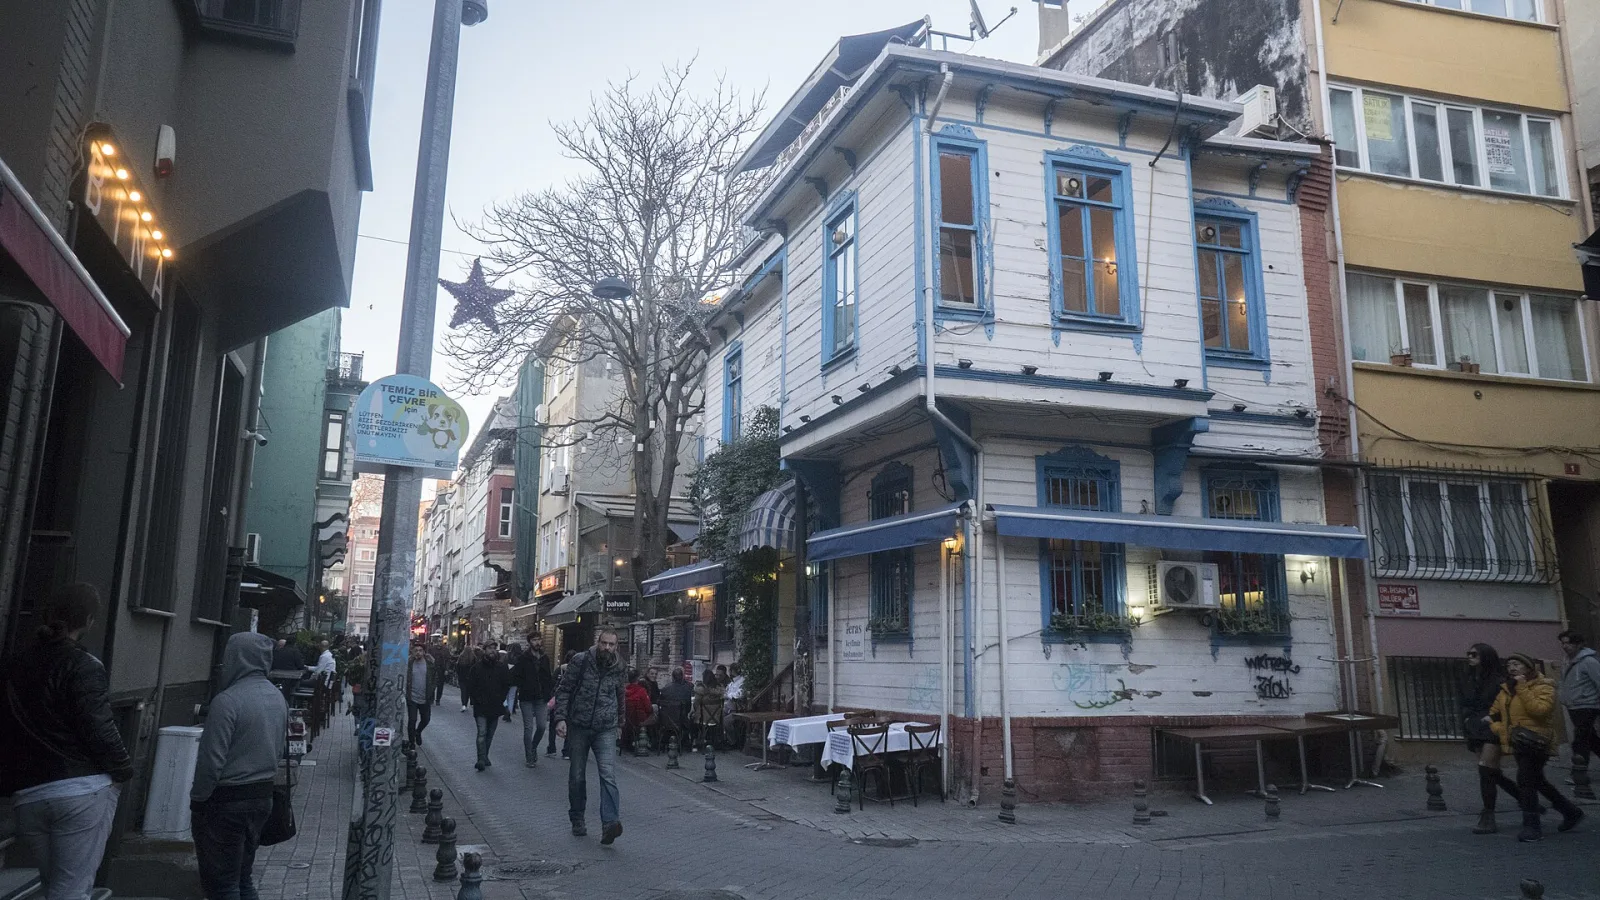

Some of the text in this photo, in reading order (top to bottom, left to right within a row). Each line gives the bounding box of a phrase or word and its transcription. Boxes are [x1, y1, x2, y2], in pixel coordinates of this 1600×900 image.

[381, 384, 437, 398] TEMİZ BİR
[388, 395, 426, 406] ÇEVRE
